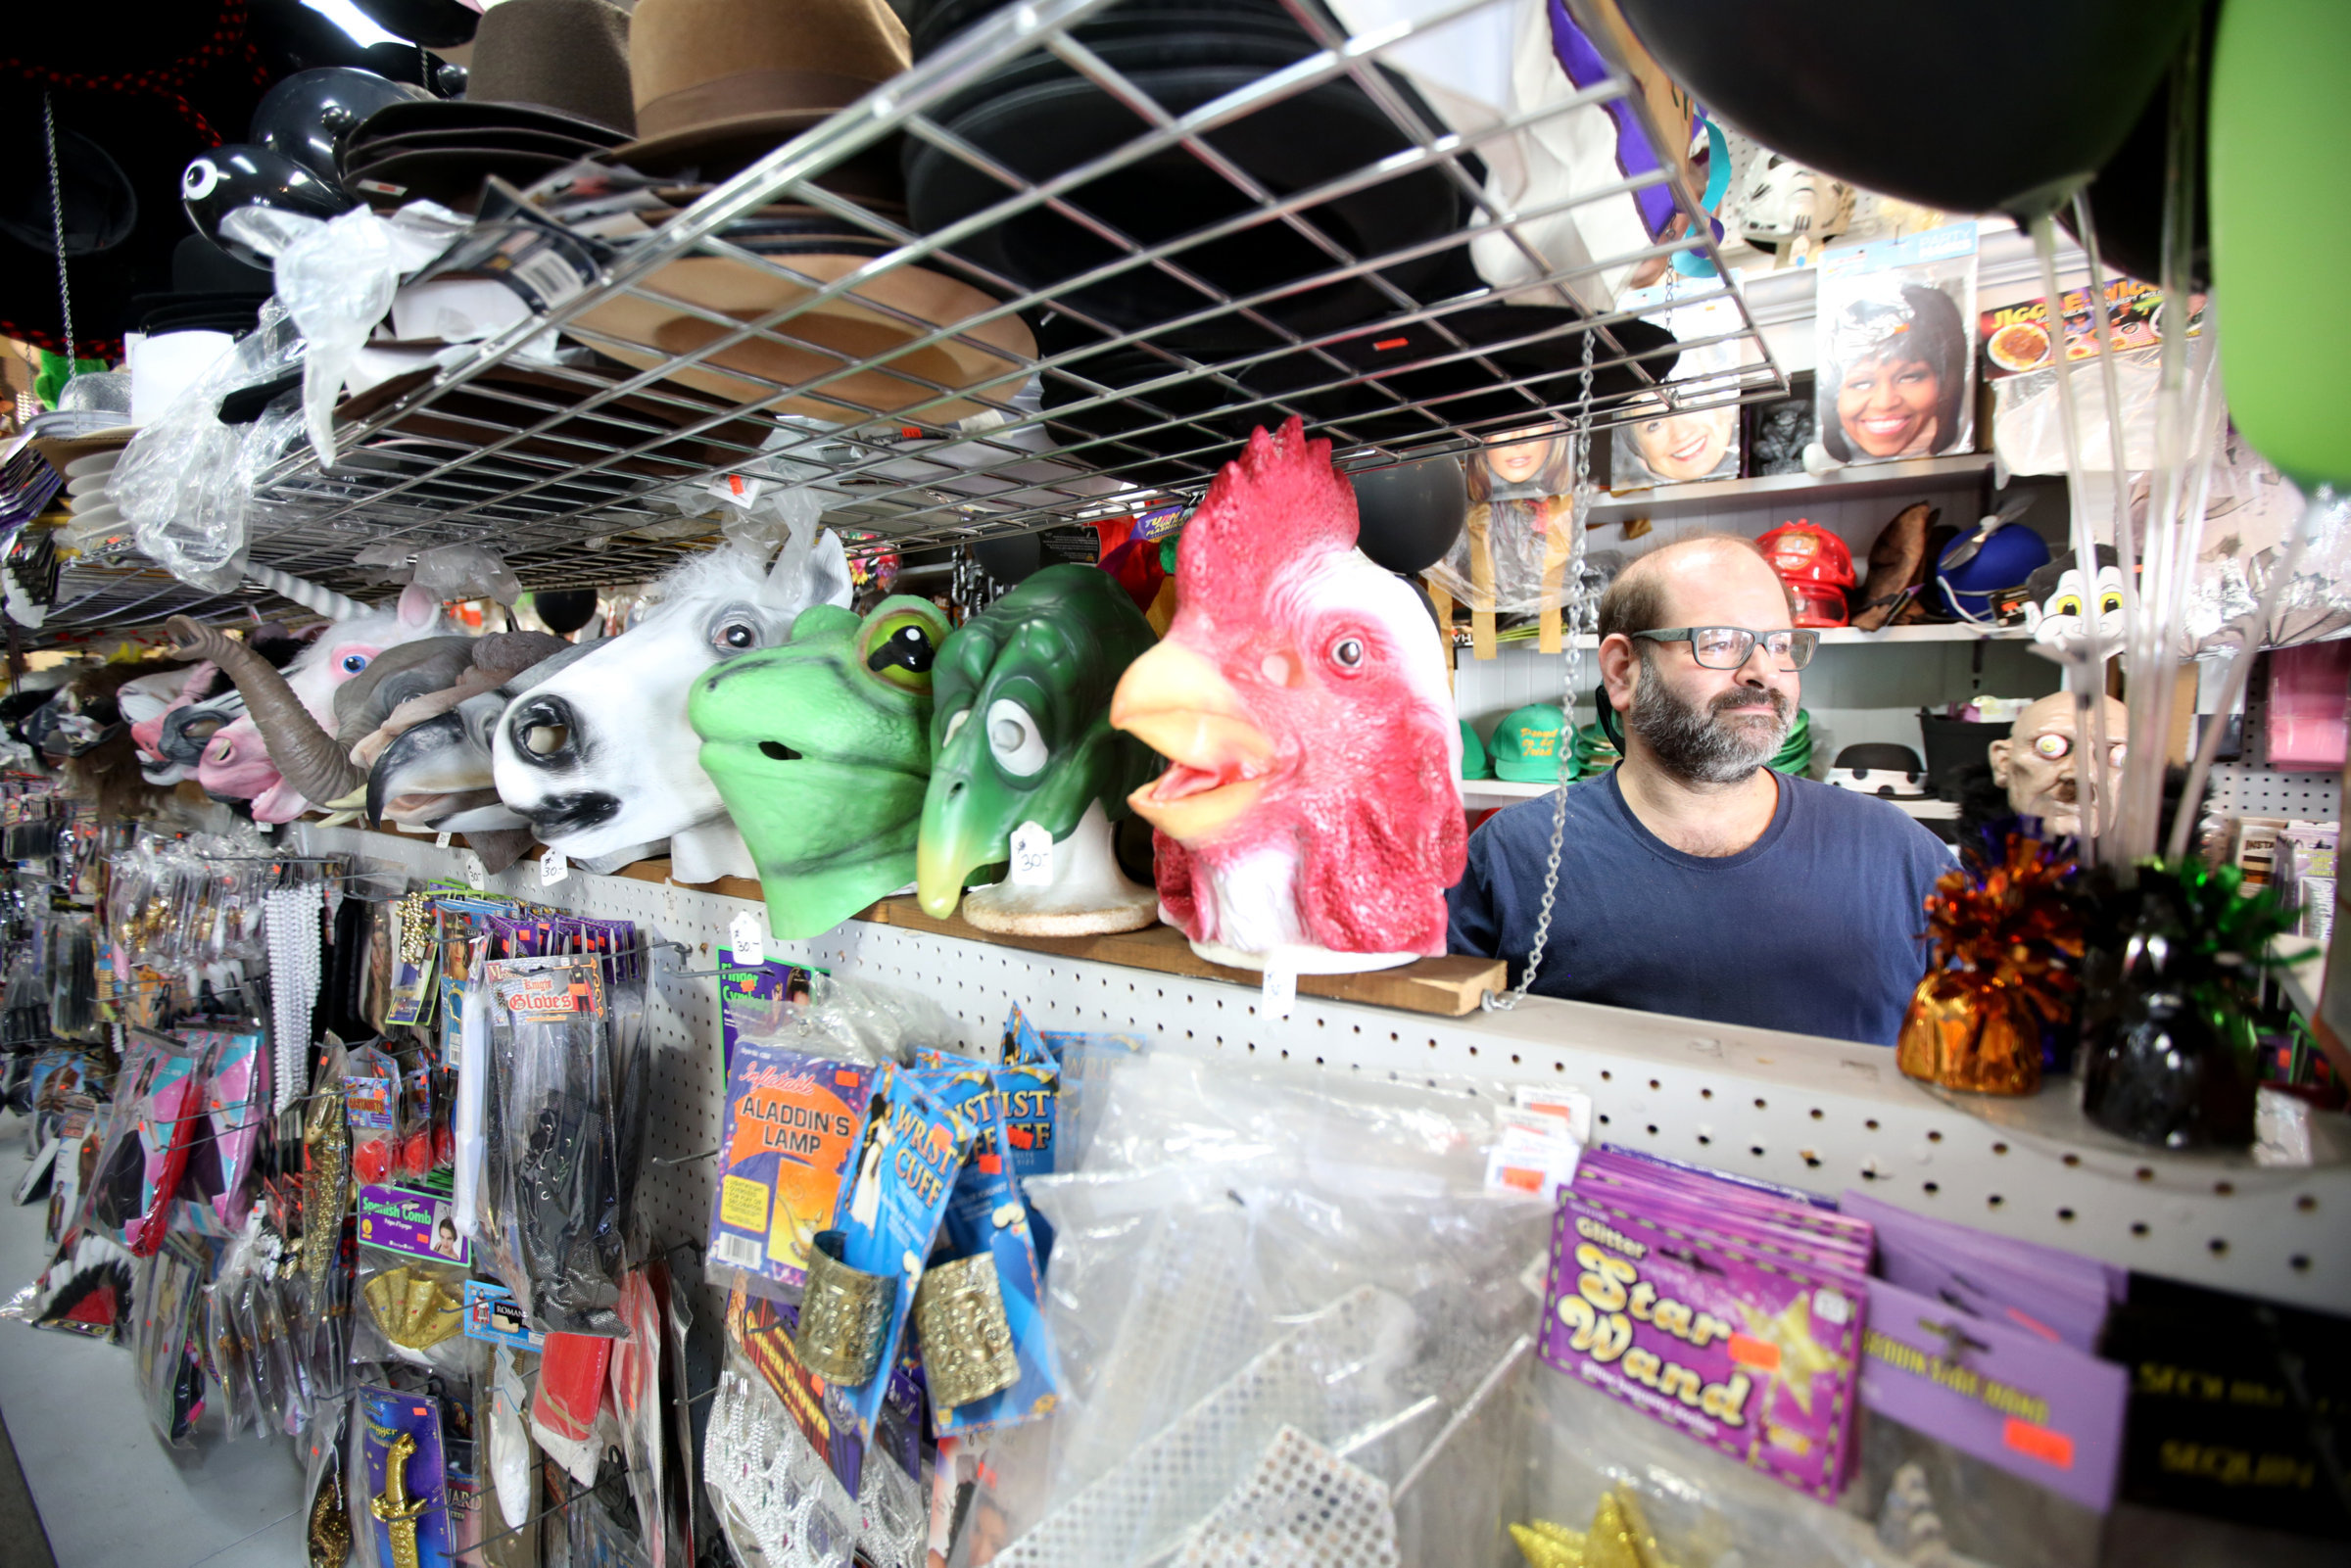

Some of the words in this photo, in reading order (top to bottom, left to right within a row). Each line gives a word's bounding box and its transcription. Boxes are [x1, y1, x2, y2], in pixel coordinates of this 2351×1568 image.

[509, 993, 573, 1011] Gloves
[739, 1061, 816, 1096] Inflatable
[742, 1096, 850, 1137] ALADDIN'S
[1002, 1089, 1052, 1117] IST
[763, 1124, 821, 1155] LAMP
[896, 1104, 958, 1175] WRIST
[894, 1147, 943, 1210] CUFF
[362, 1197, 400, 1217] Spanish
[403, 1208, 432, 1225] Comb
[1575, 1215, 1647, 1259] Glitter
[1574, 1242, 1733, 1347] Star
[1557, 1294, 1751, 1427] Wand
[448, 1487, 482, 1510] UARD
